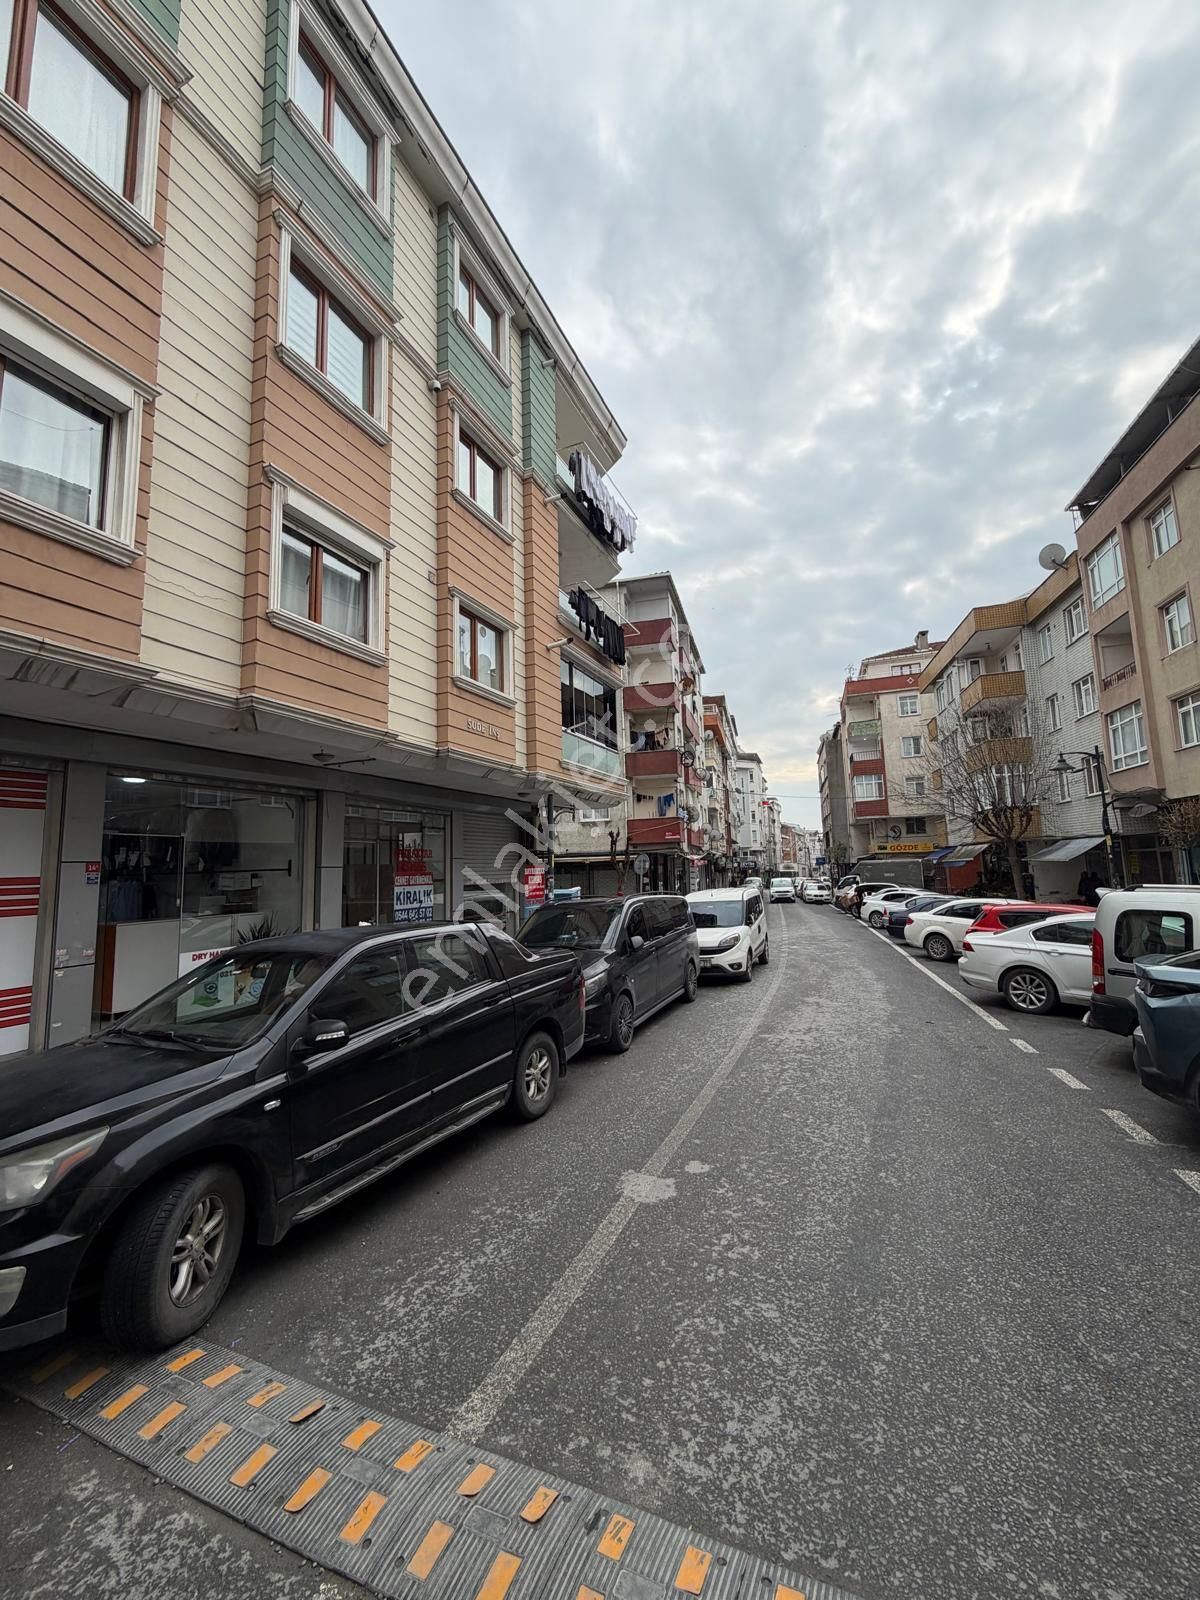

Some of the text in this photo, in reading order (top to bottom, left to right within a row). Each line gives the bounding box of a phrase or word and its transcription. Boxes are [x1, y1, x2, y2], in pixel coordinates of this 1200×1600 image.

[467, 719, 486, 733] SUDE
[890, 843, 919, 851] GÖZDE
[395, 888, 432, 906] KİRALIK
[395, 910, 408, 921] 0544
[192, 952, 208, 962] DRY
